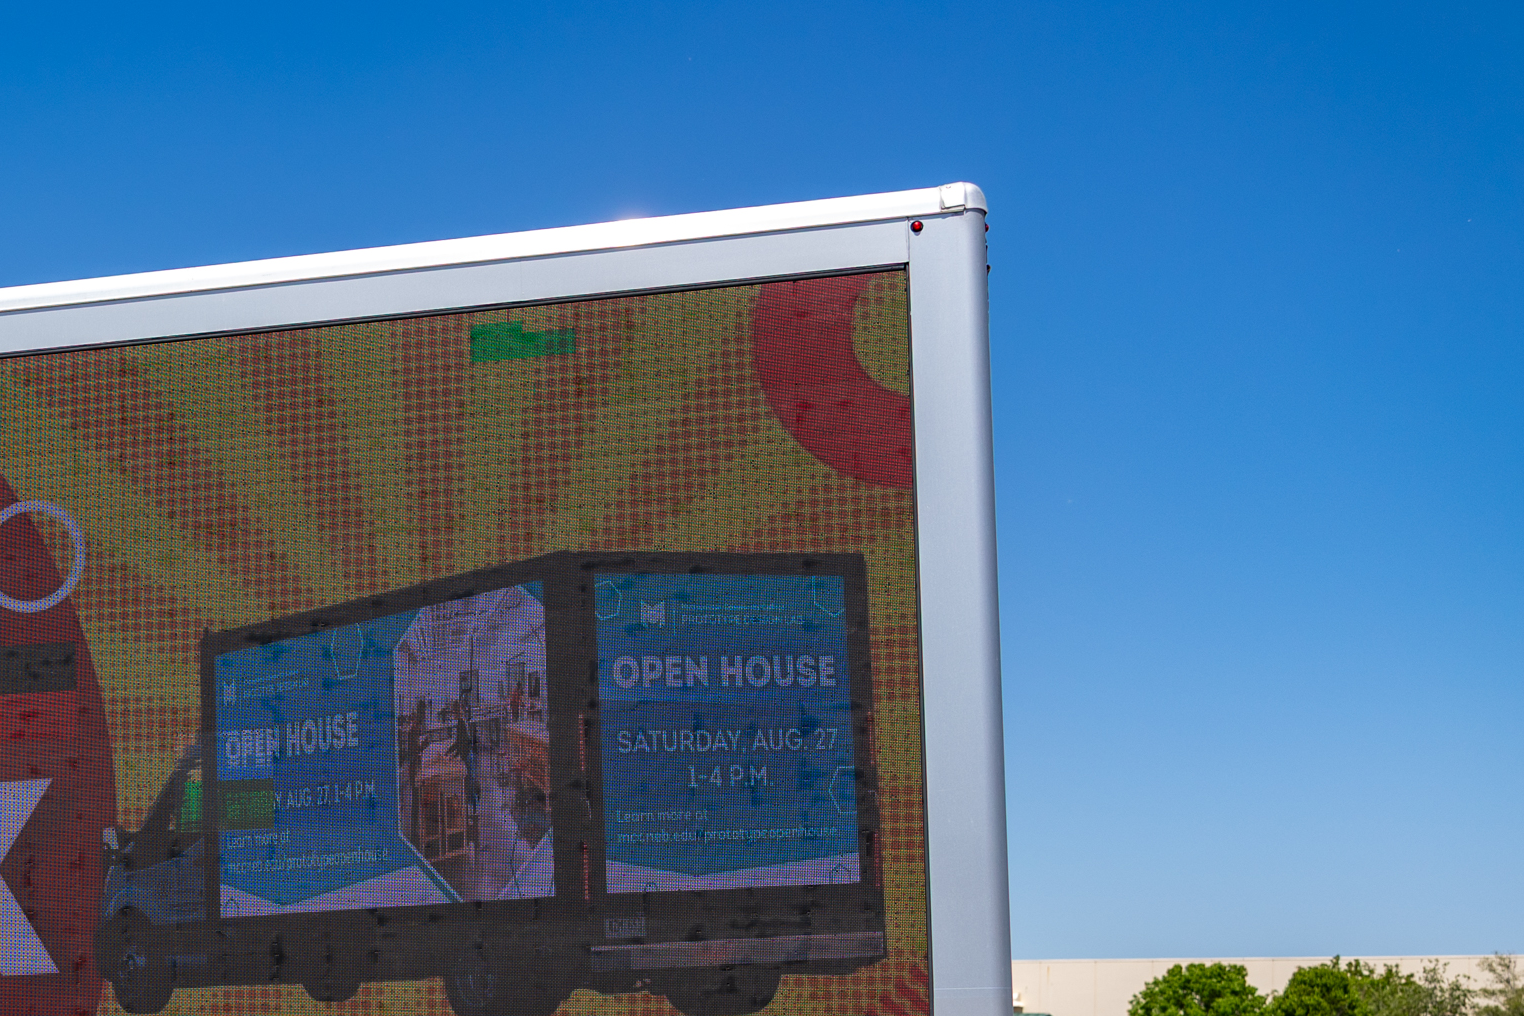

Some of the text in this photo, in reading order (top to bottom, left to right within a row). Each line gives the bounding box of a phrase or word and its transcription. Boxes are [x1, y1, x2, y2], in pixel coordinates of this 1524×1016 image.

[612, 654, 837, 688] OPEN HOUSE
[226, 711, 359, 767] OPEN HOUSE
[617, 727, 839, 753] SATURDAY, AUG. 27
[688, 764, 775, 788] 1-4 P.M.
[616, 809, 656, 824] Learn
